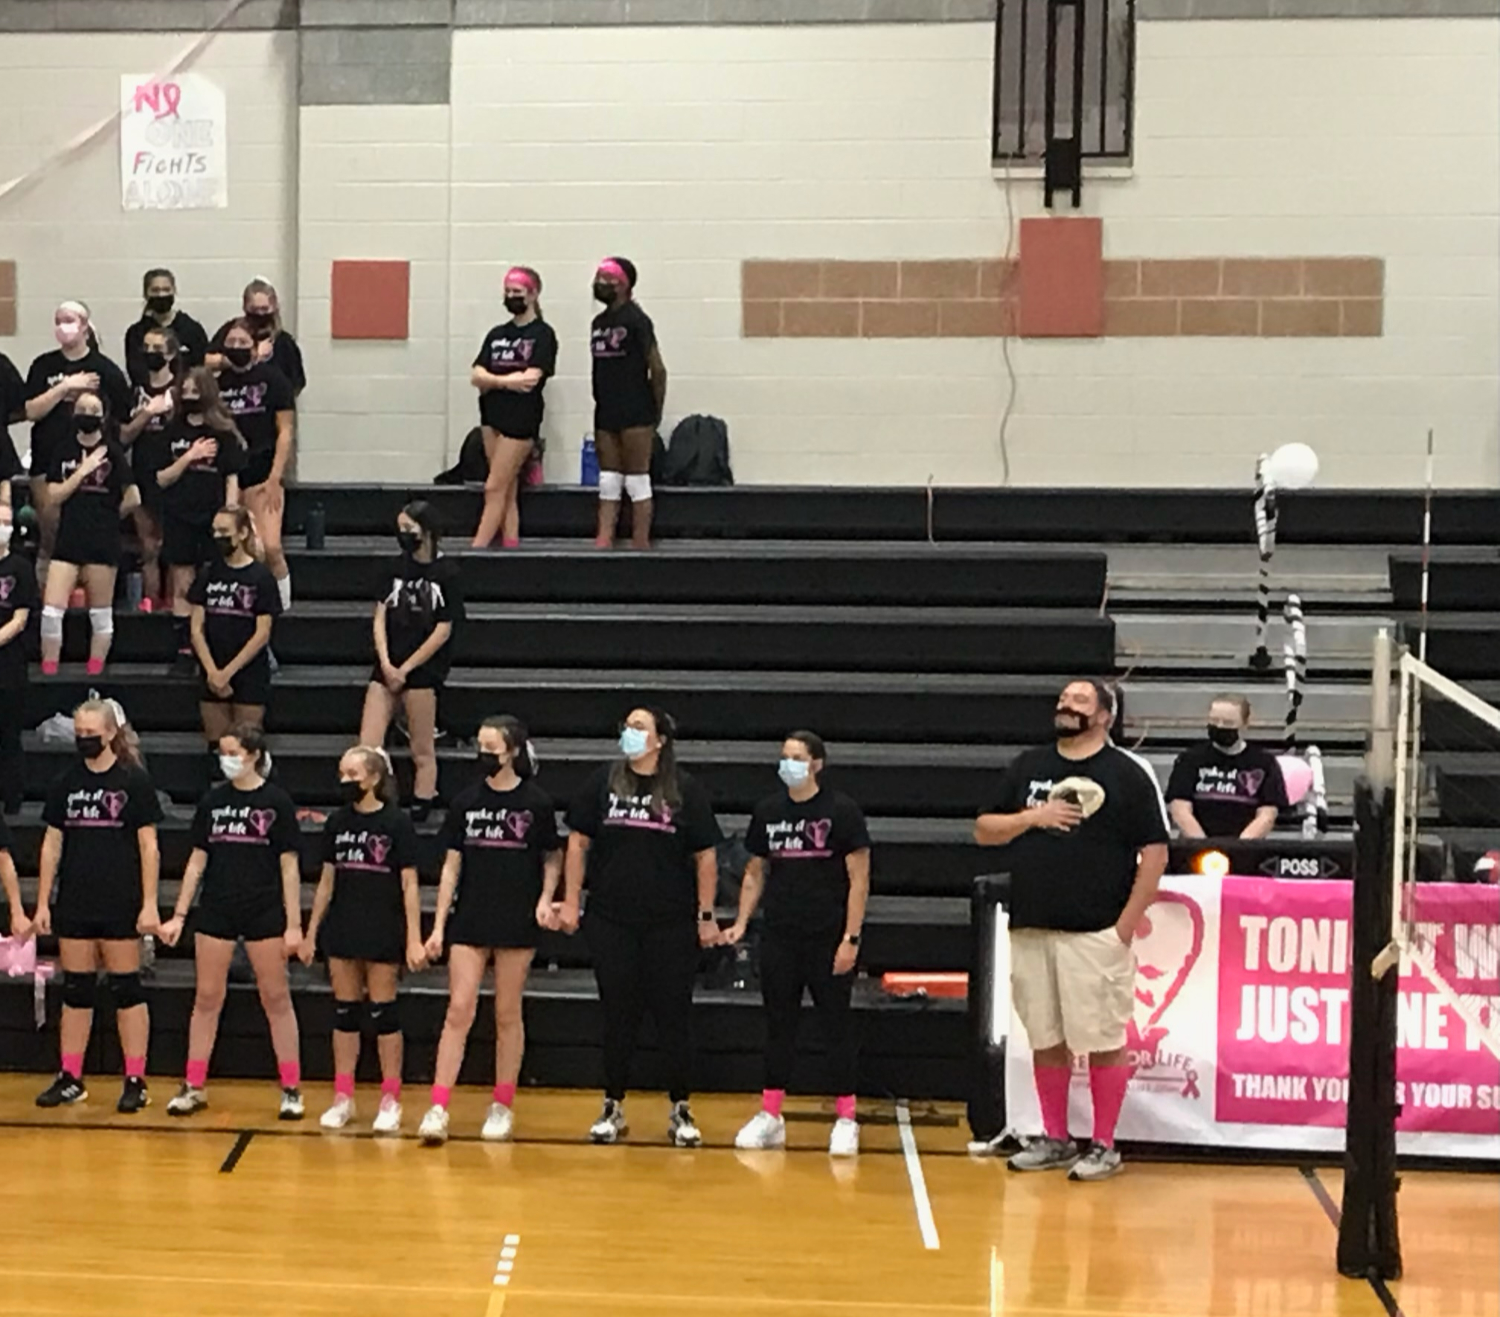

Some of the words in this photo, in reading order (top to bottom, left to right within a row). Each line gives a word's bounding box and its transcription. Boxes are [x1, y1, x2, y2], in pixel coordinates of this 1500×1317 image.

[1280, 858, 1319, 876] POSS
[1236, 985, 1350, 1045] JUST
[1395, 991, 1449, 1050] NE
[1158, 1048, 1194, 1072] LIFE
[1232, 1074, 1308, 1101] THANK
[1411, 1082, 1473, 1109] YOUR
